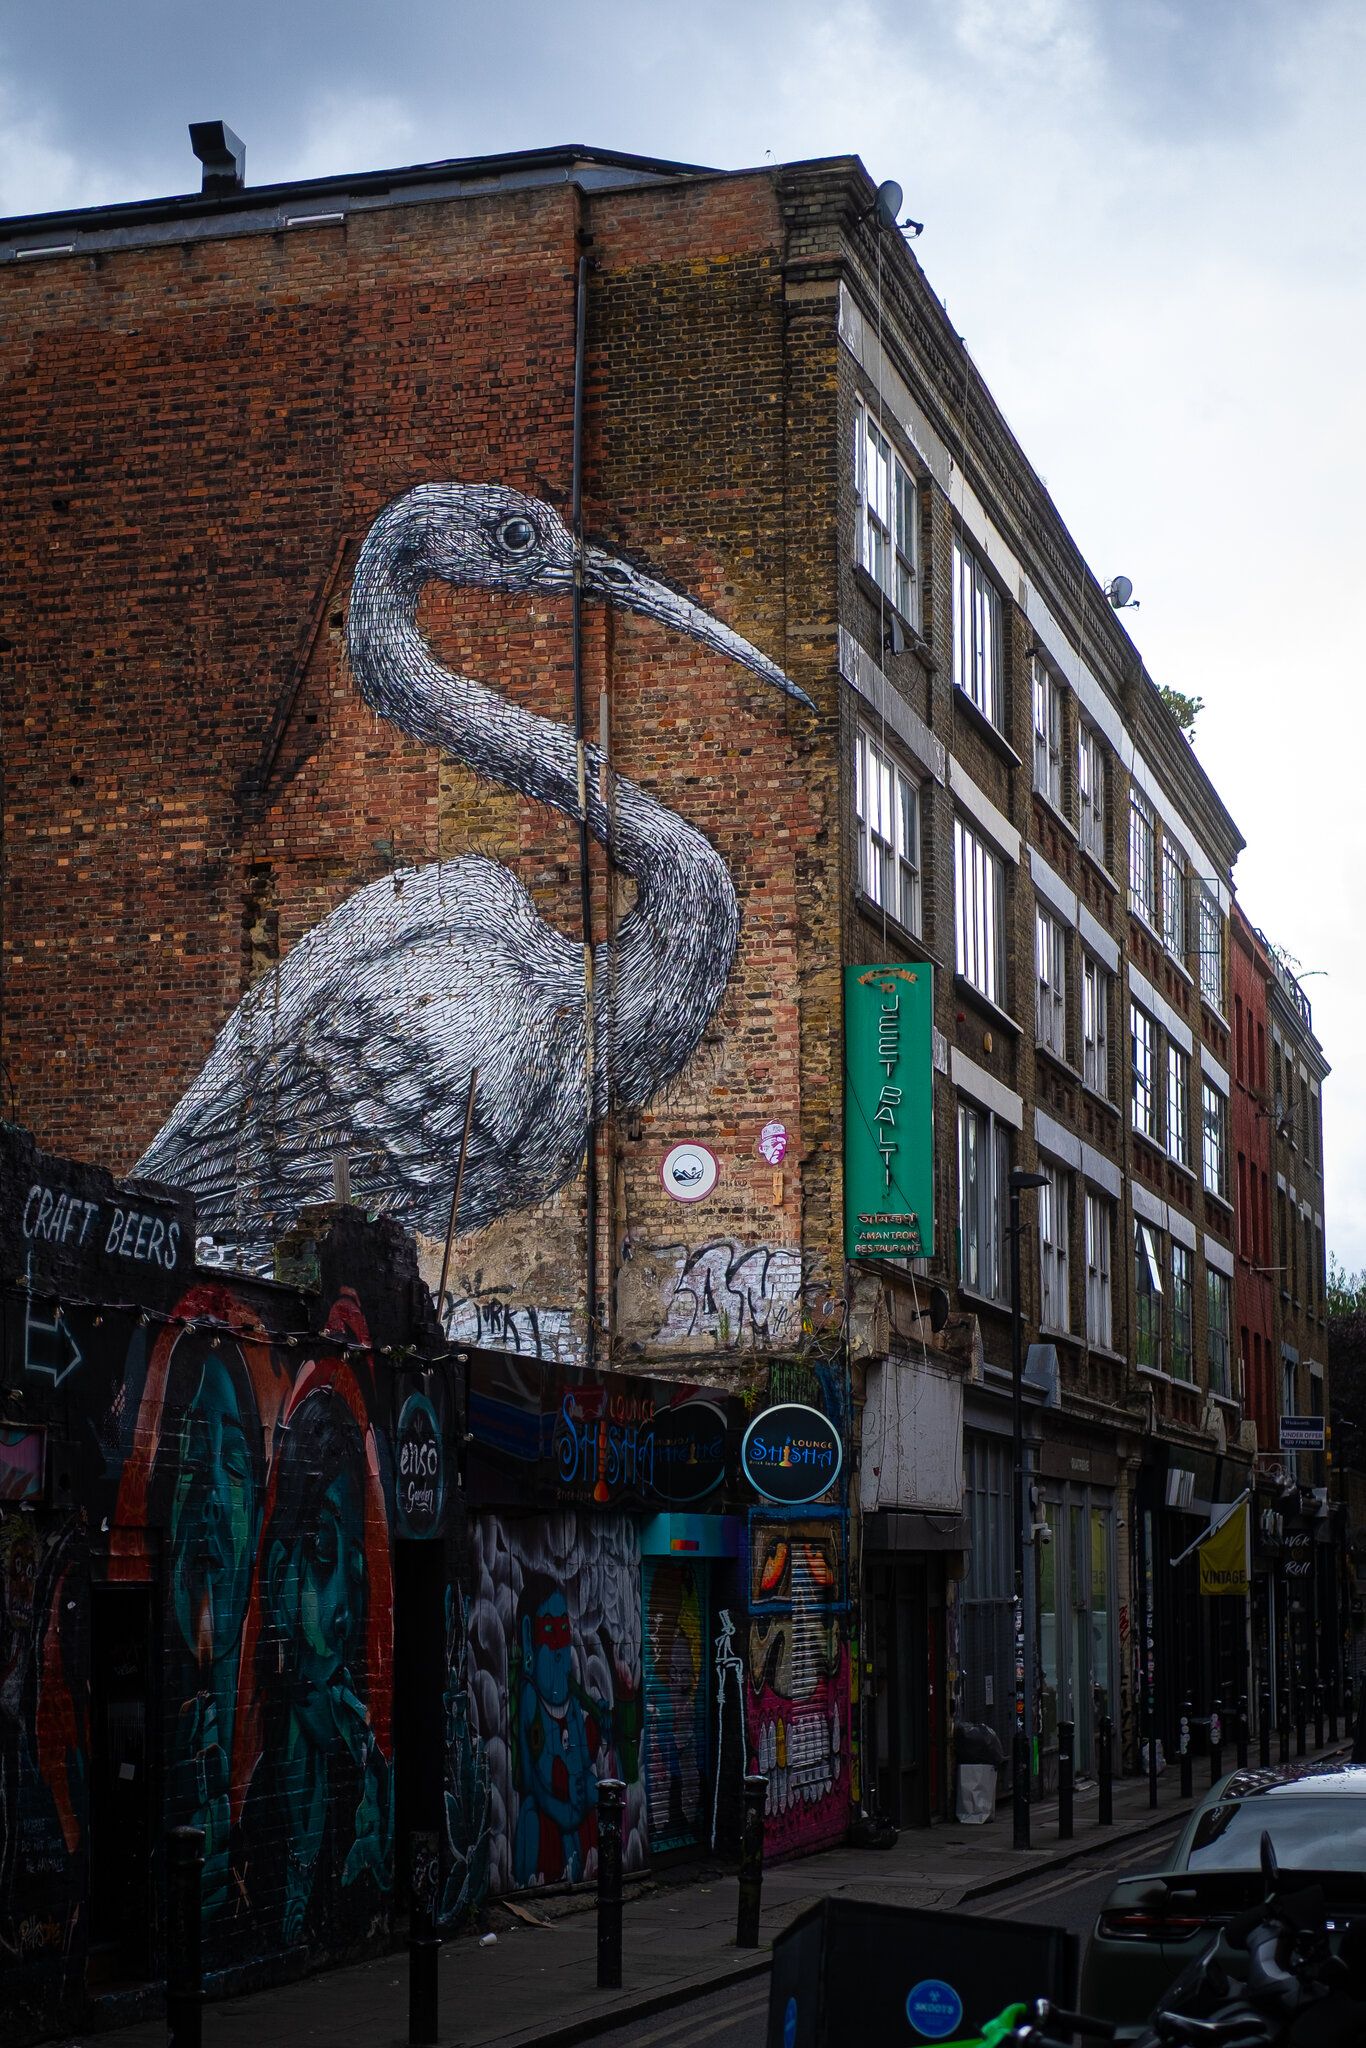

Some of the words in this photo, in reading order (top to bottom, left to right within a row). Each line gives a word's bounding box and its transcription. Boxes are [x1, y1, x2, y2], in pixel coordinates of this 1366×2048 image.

[878, 995, 900, 1077] JEET
[874, 1085, 903, 1186] BALTI
[22, 1184, 100, 1247] CRAFT
[105, 1207, 181, 1271] BEERS
[792, 1439, 833, 1449] LOUNGE
[749, 1437, 833, 1468] SHISHA
[1285, 1533, 1310, 1548] Wok
[1284, 1560, 1311, 1576] Roll
[1202, 1570, 1246, 1584] VINTAGE
[913, 2002, 954, 2015] SKOOTS
